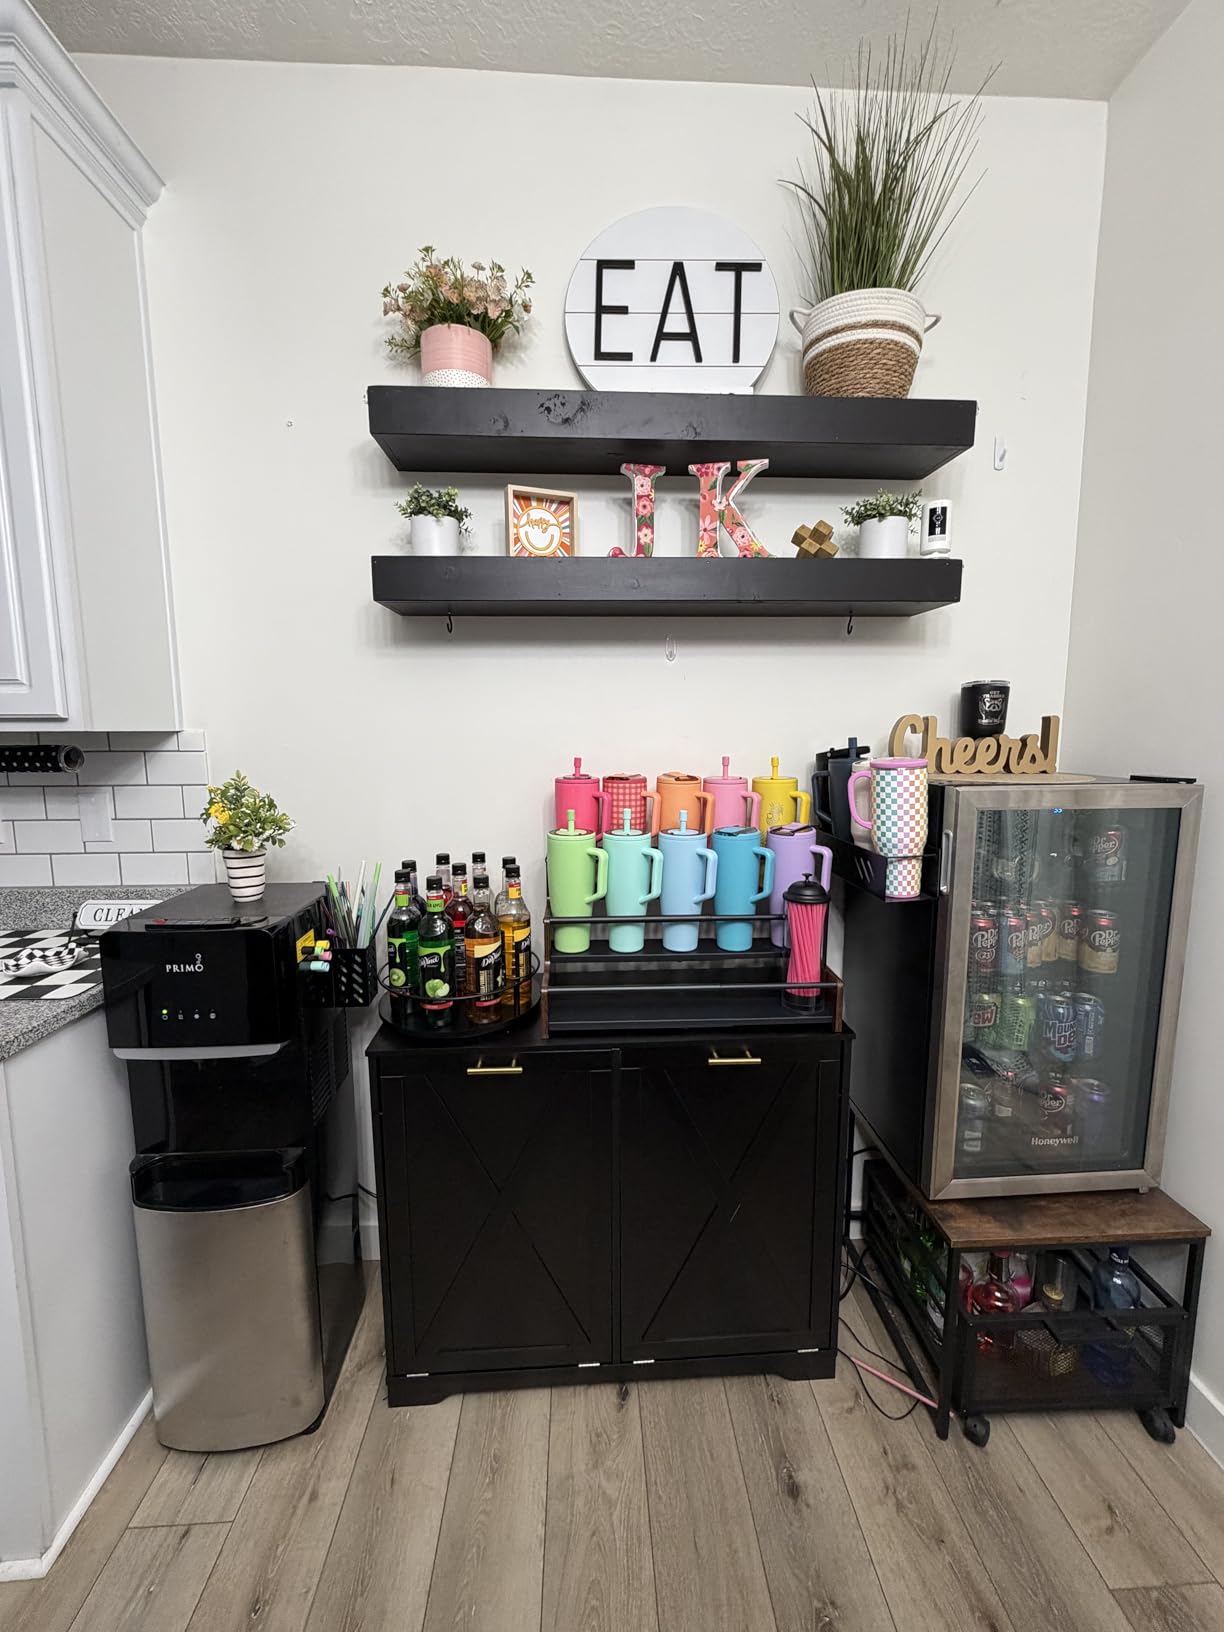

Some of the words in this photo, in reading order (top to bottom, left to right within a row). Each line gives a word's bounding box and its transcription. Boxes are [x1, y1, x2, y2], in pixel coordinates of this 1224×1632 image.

[594, 260, 762, 363] EAT
[525, 512, 550, 533] happy
[888, 714, 1060, 774] Cheers!
[165, 961, 204, 973] PRIMO
[1031, 1135, 1079, 1146] Honeywell
